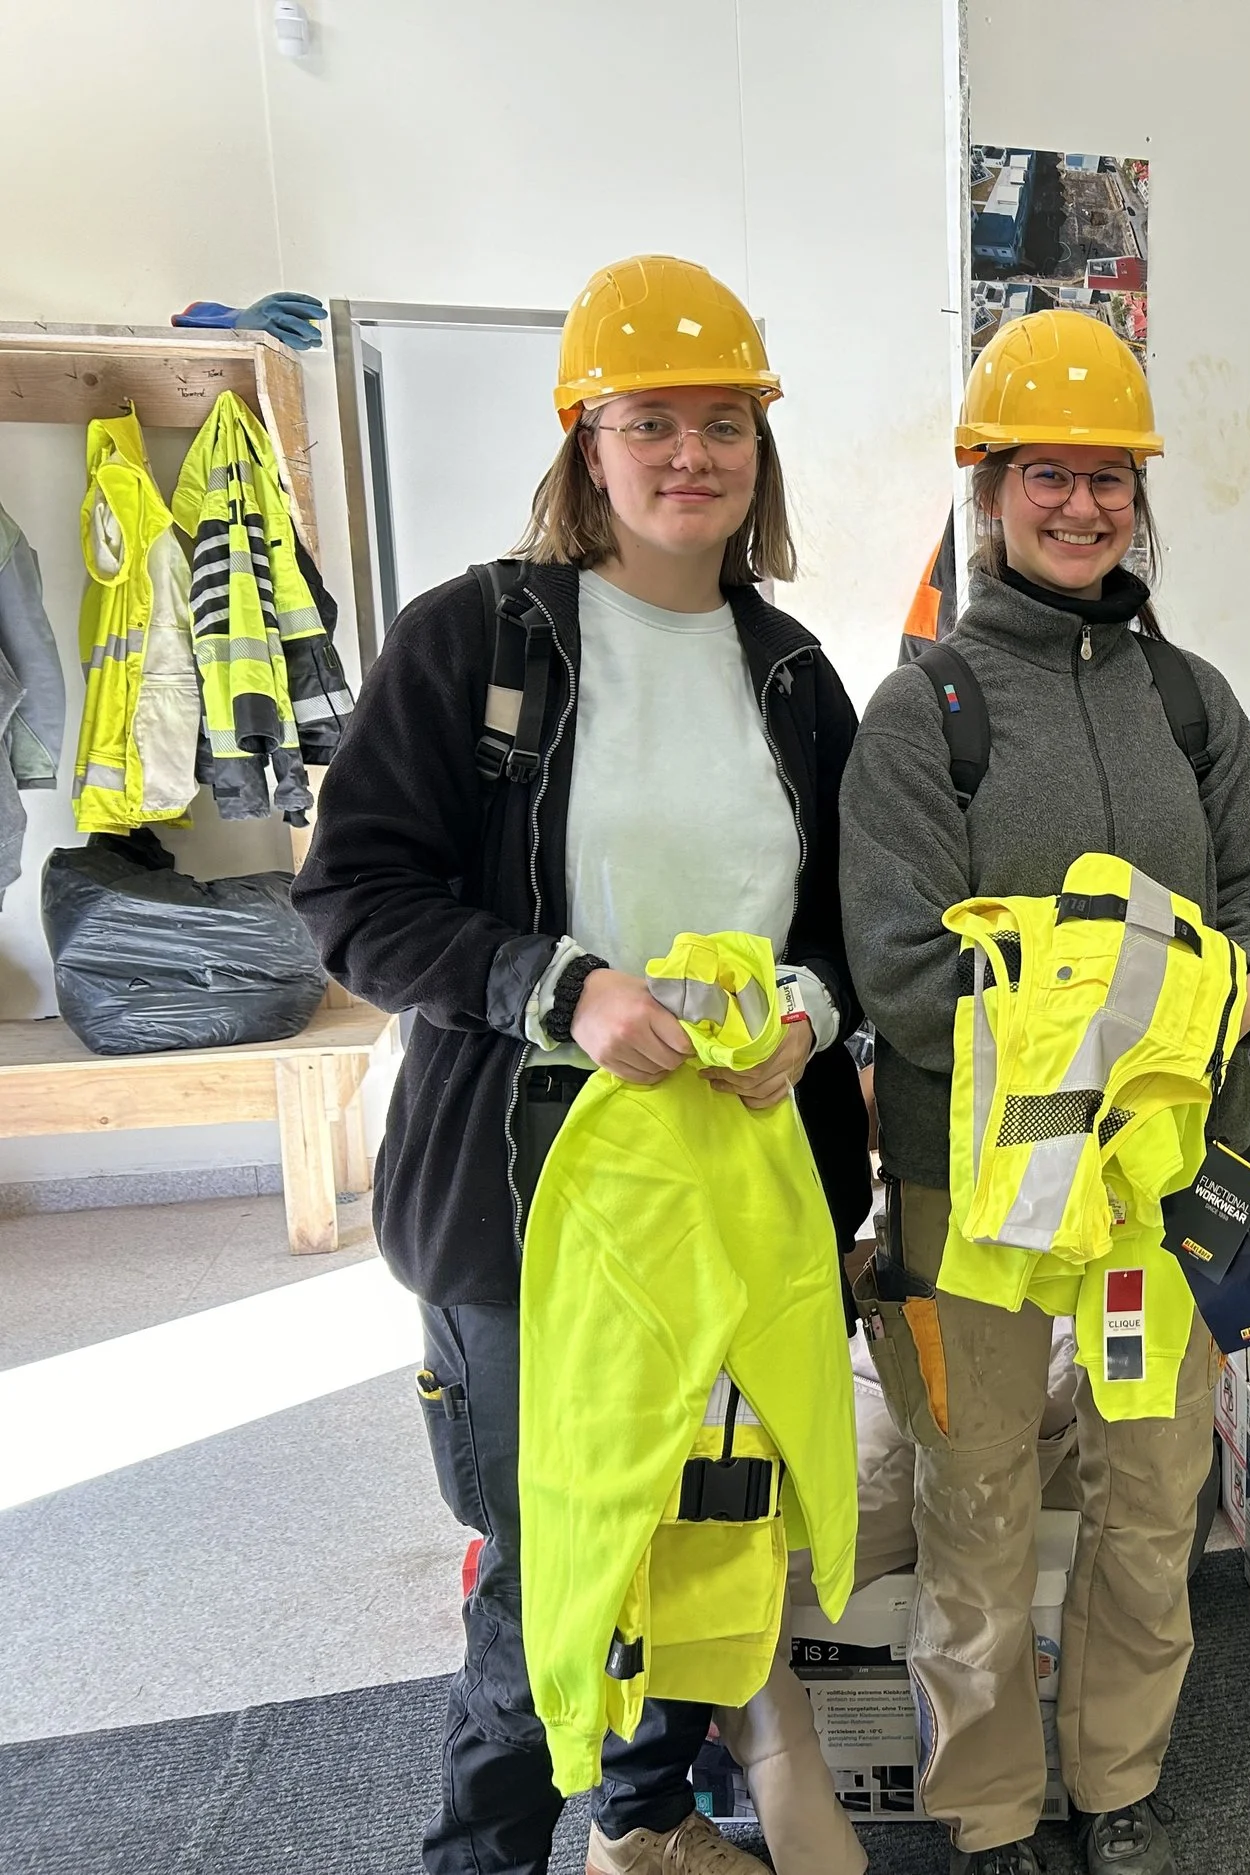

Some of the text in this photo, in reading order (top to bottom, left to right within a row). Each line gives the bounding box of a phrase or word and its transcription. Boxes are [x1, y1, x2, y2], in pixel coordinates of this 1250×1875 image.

[783, 985, 794, 1012] CLIQUE
[1195, 1184, 1248, 1225] WORKWEAR
[1199, 1174, 1250, 1216] FUNCTIONAL
[1108, 1319, 1141, 1329] CLIQUE
[804, 1645, 840, 1661] IS 2
